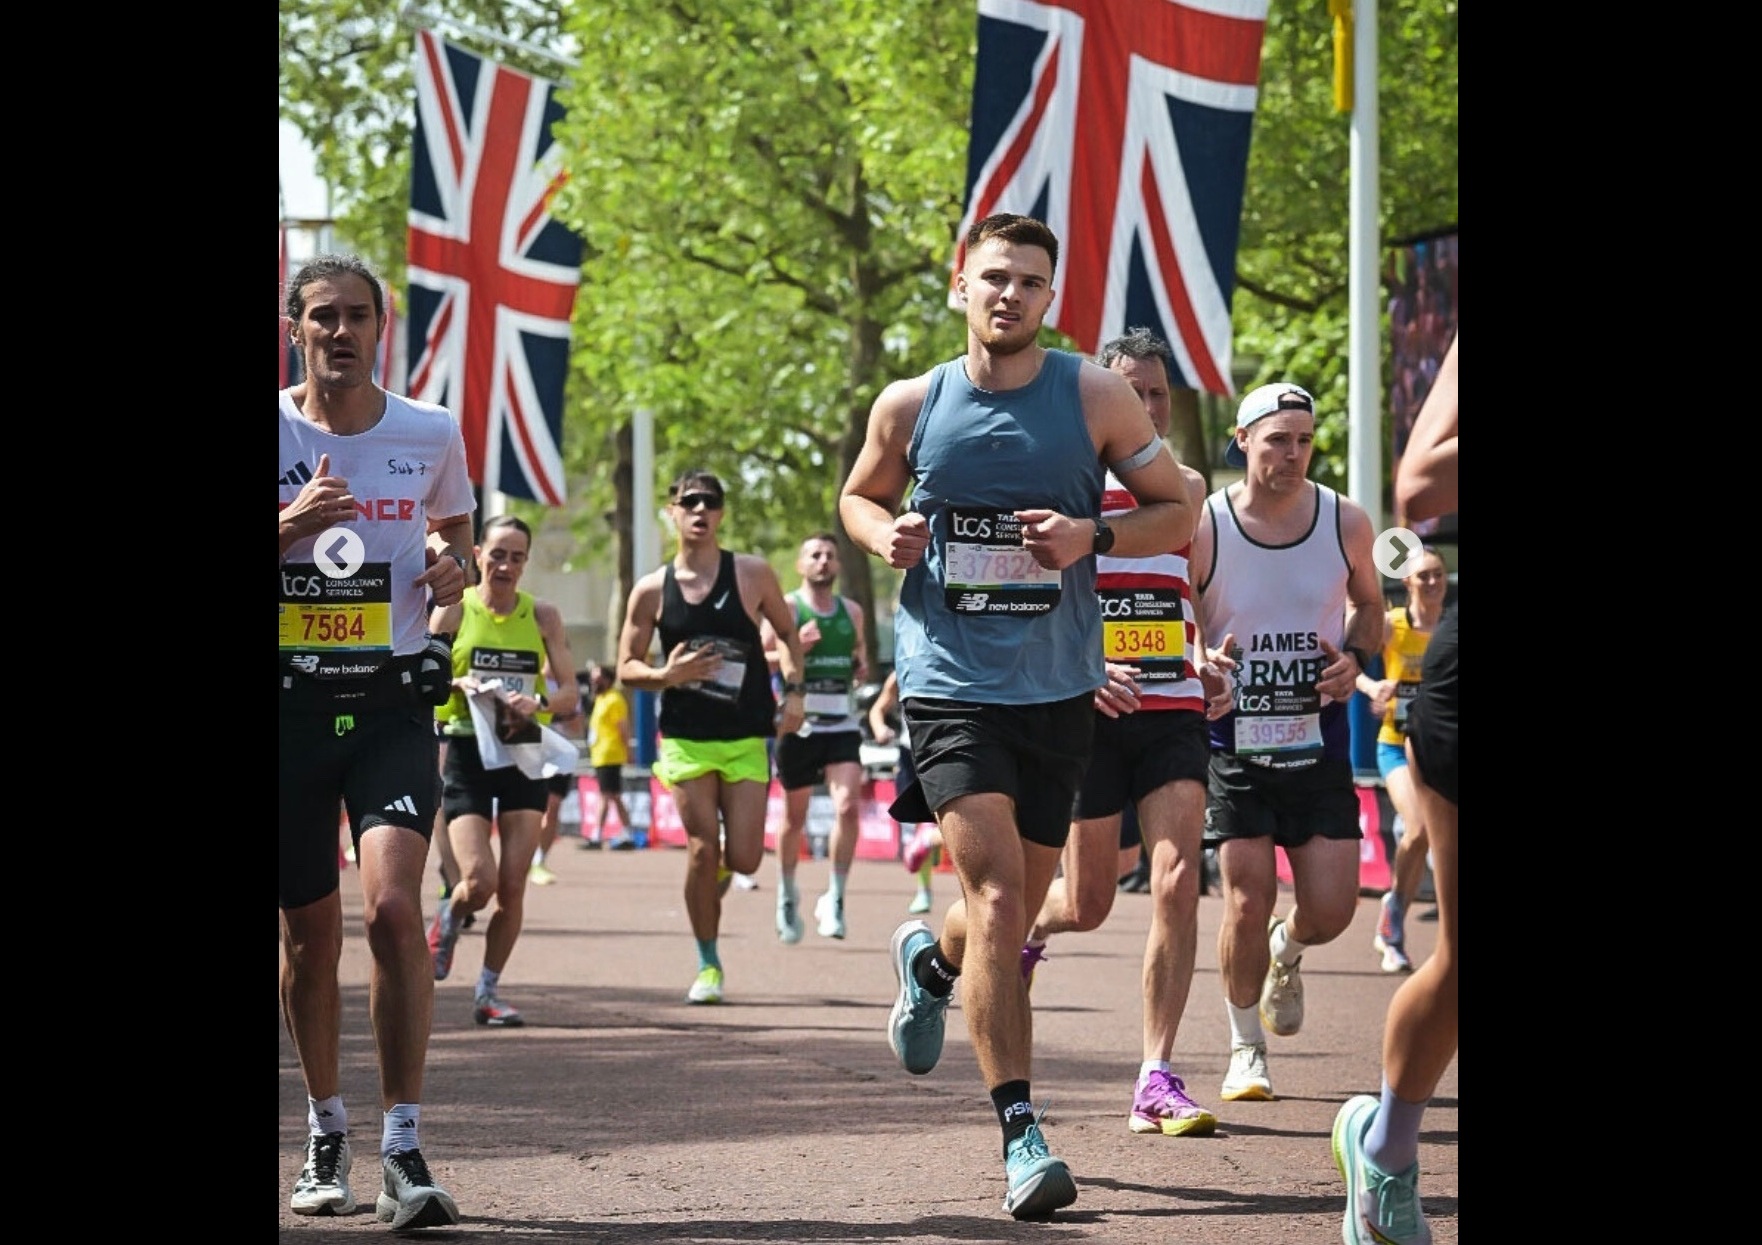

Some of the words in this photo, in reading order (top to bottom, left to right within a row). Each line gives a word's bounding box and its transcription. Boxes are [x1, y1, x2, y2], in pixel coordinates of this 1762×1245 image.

[388, 459, 414, 475] Sub
[352, 499, 417, 521] NCE
[952, 512, 992, 538] tcs
[962, 552, 1043, 580] 37824
[281, 571, 321, 597] tcs
[325, 578, 385, 588] CONSULTANCY
[325, 588, 364, 597] SERVICES
[988, 603, 1009, 611] new
[1010, 602, 1051, 611] balance
[1134, 593, 1155, 601] TATA
[301, 612, 366, 642] 7584
[1114, 629, 1166, 653] 3348
[1250, 631, 1319, 653] JAMES
[319, 665, 340, 675] new
[341, 664, 379, 674] balanc
[1239, 690, 1271, 711] tcs
[1249, 721, 1307, 744] 39555
